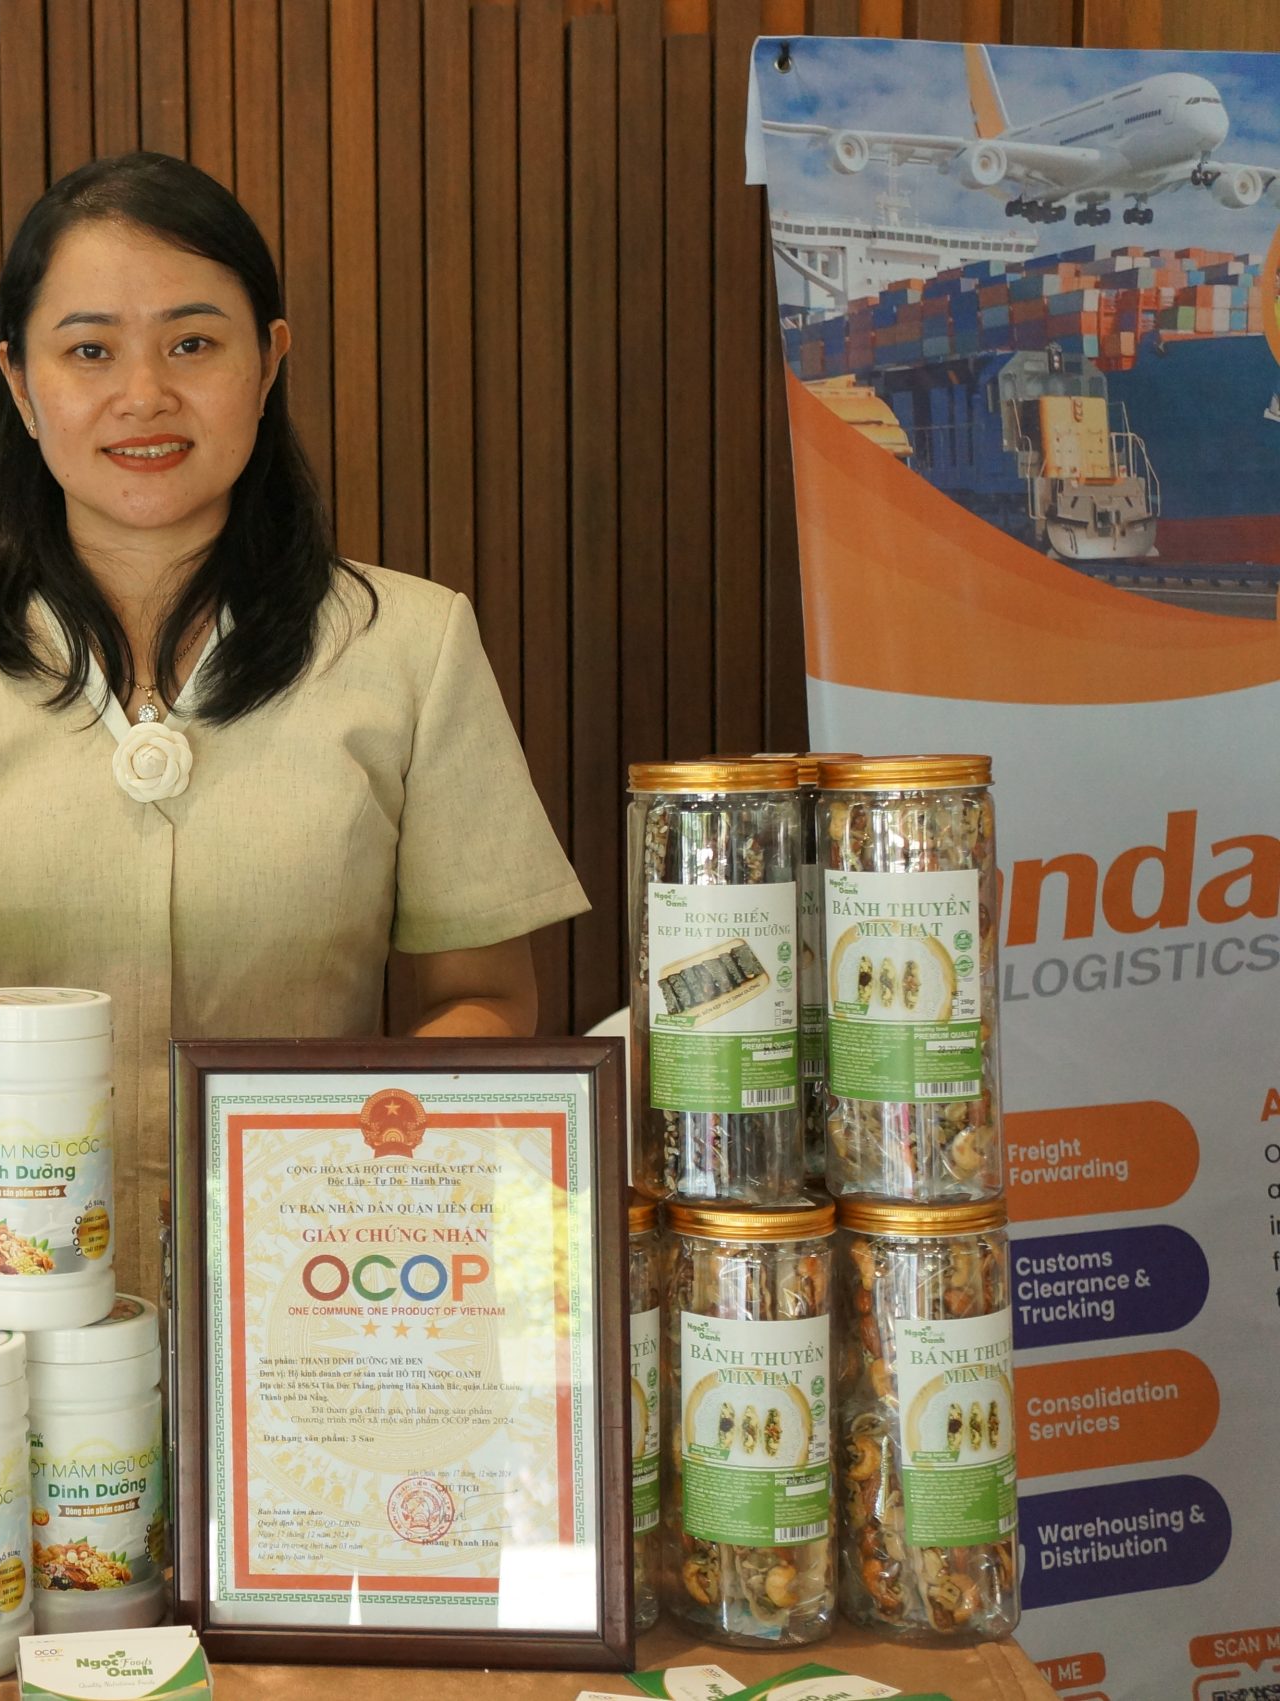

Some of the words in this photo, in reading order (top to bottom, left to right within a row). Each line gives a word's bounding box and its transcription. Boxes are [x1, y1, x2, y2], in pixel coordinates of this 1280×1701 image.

[996, 809, 1280, 947] nda
[832, 897, 880, 917] BÁNH
[887, 893, 972, 918] THUYỀN
[685, 912, 728, 924] RONG
[658, 925, 681, 938] KẸP
[685, 927, 713, 941] HẠT
[717, 927, 750, 938] DINH
[754, 923, 791, 938] DƯỠNG
[856, 921, 892, 937] MIX
[900, 922, 943, 941] HẠT
[1003, 934, 1280, 1003] LOGISTICS
[22, 1141, 61, 1159] NGŨ
[66, 1136, 100, 1157] CỐC
[1007, 1138, 1081, 1165] Freight
[16, 1163, 76, 1181] Dưỡng
[286, 1163, 318, 1175] CỘNG
[320, 1163, 344, 1174] HÒA
[346, 1163, 360, 1174] XÃ
[363, 1163, 385, 1175] HỘI
[386, 1162, 409, 1174] CHỦ
[411, 1162, 447, 1174] NGHĨA
[449, 1163, 475, 1175] VIỆT
[477, 1164, 503, 1174] NAM
[1009, 1158, 1129, 1187] Forwarding
[299, 1204, 325, 1214] BAN
[328, 1202, 363, 1214] NHÂN
[368, 1202, 395, 1214] DÂN
[397, 1202, 434, 1215] QUẬN
[437, 1201, 467, 1214] LIÊN
[302, 1225, 351, 1243] GIẤY
[355, 1225, 427, 1243] CHỨNG
[432, 1227, 489, 1246] NHẬN
[1015, 1250, 1113, 1277] Customs
[302, 1254, 490, 1302] OCOP
[1017, 1272, 1130, 1301] Clearance
[1134, 1268, 1152, 1289] &
[288, 1306, 310, 1317] ONE
[312, 1306, 364, 1317] COMMUNE
[367, 1306, 389, 1316] ONE
[391, 1306, 440, 1316] PRODUCT
[443, 1306, 458, 1316] OF
[460, 1306, 506, 1316] VIETNAM
[1018, 1298, 1116, 1325] Trucking
[300, 1357, 330, 1366] THANH
[332, 1357, 354, 1366] DINH
[690, 1343, 745, 1366] BÁNH
[751, 1341, 825, 1366] THUYỀN
[910, 1346, 969, 1365] BÁNH
[974, 1338, 1012, 1362] THUY
[718, 1368, 756, 1386] MIX
[763, 1370, 802, 1389] HẠT
[944, 1367, 980, 1385] MIX
[1026, 1381, 1179, 1418] Consolidation
[1028, 1414, 1120, 1441] Services
[1037, 1507, 1185, 1546] Warehousing
[1188, 1504, 1206, 1524] &
[1040, 1535, 1168, 1571] Distribution
[1213, 1636, 1260, 1658] SCAN
[76, 1658, 119, 1670] Ngọc
[121, 1657, 152, 1667] Foods
[106, 1667, 153, 1677] Oanh
[1058, 1661, 1083, 1682] ME
